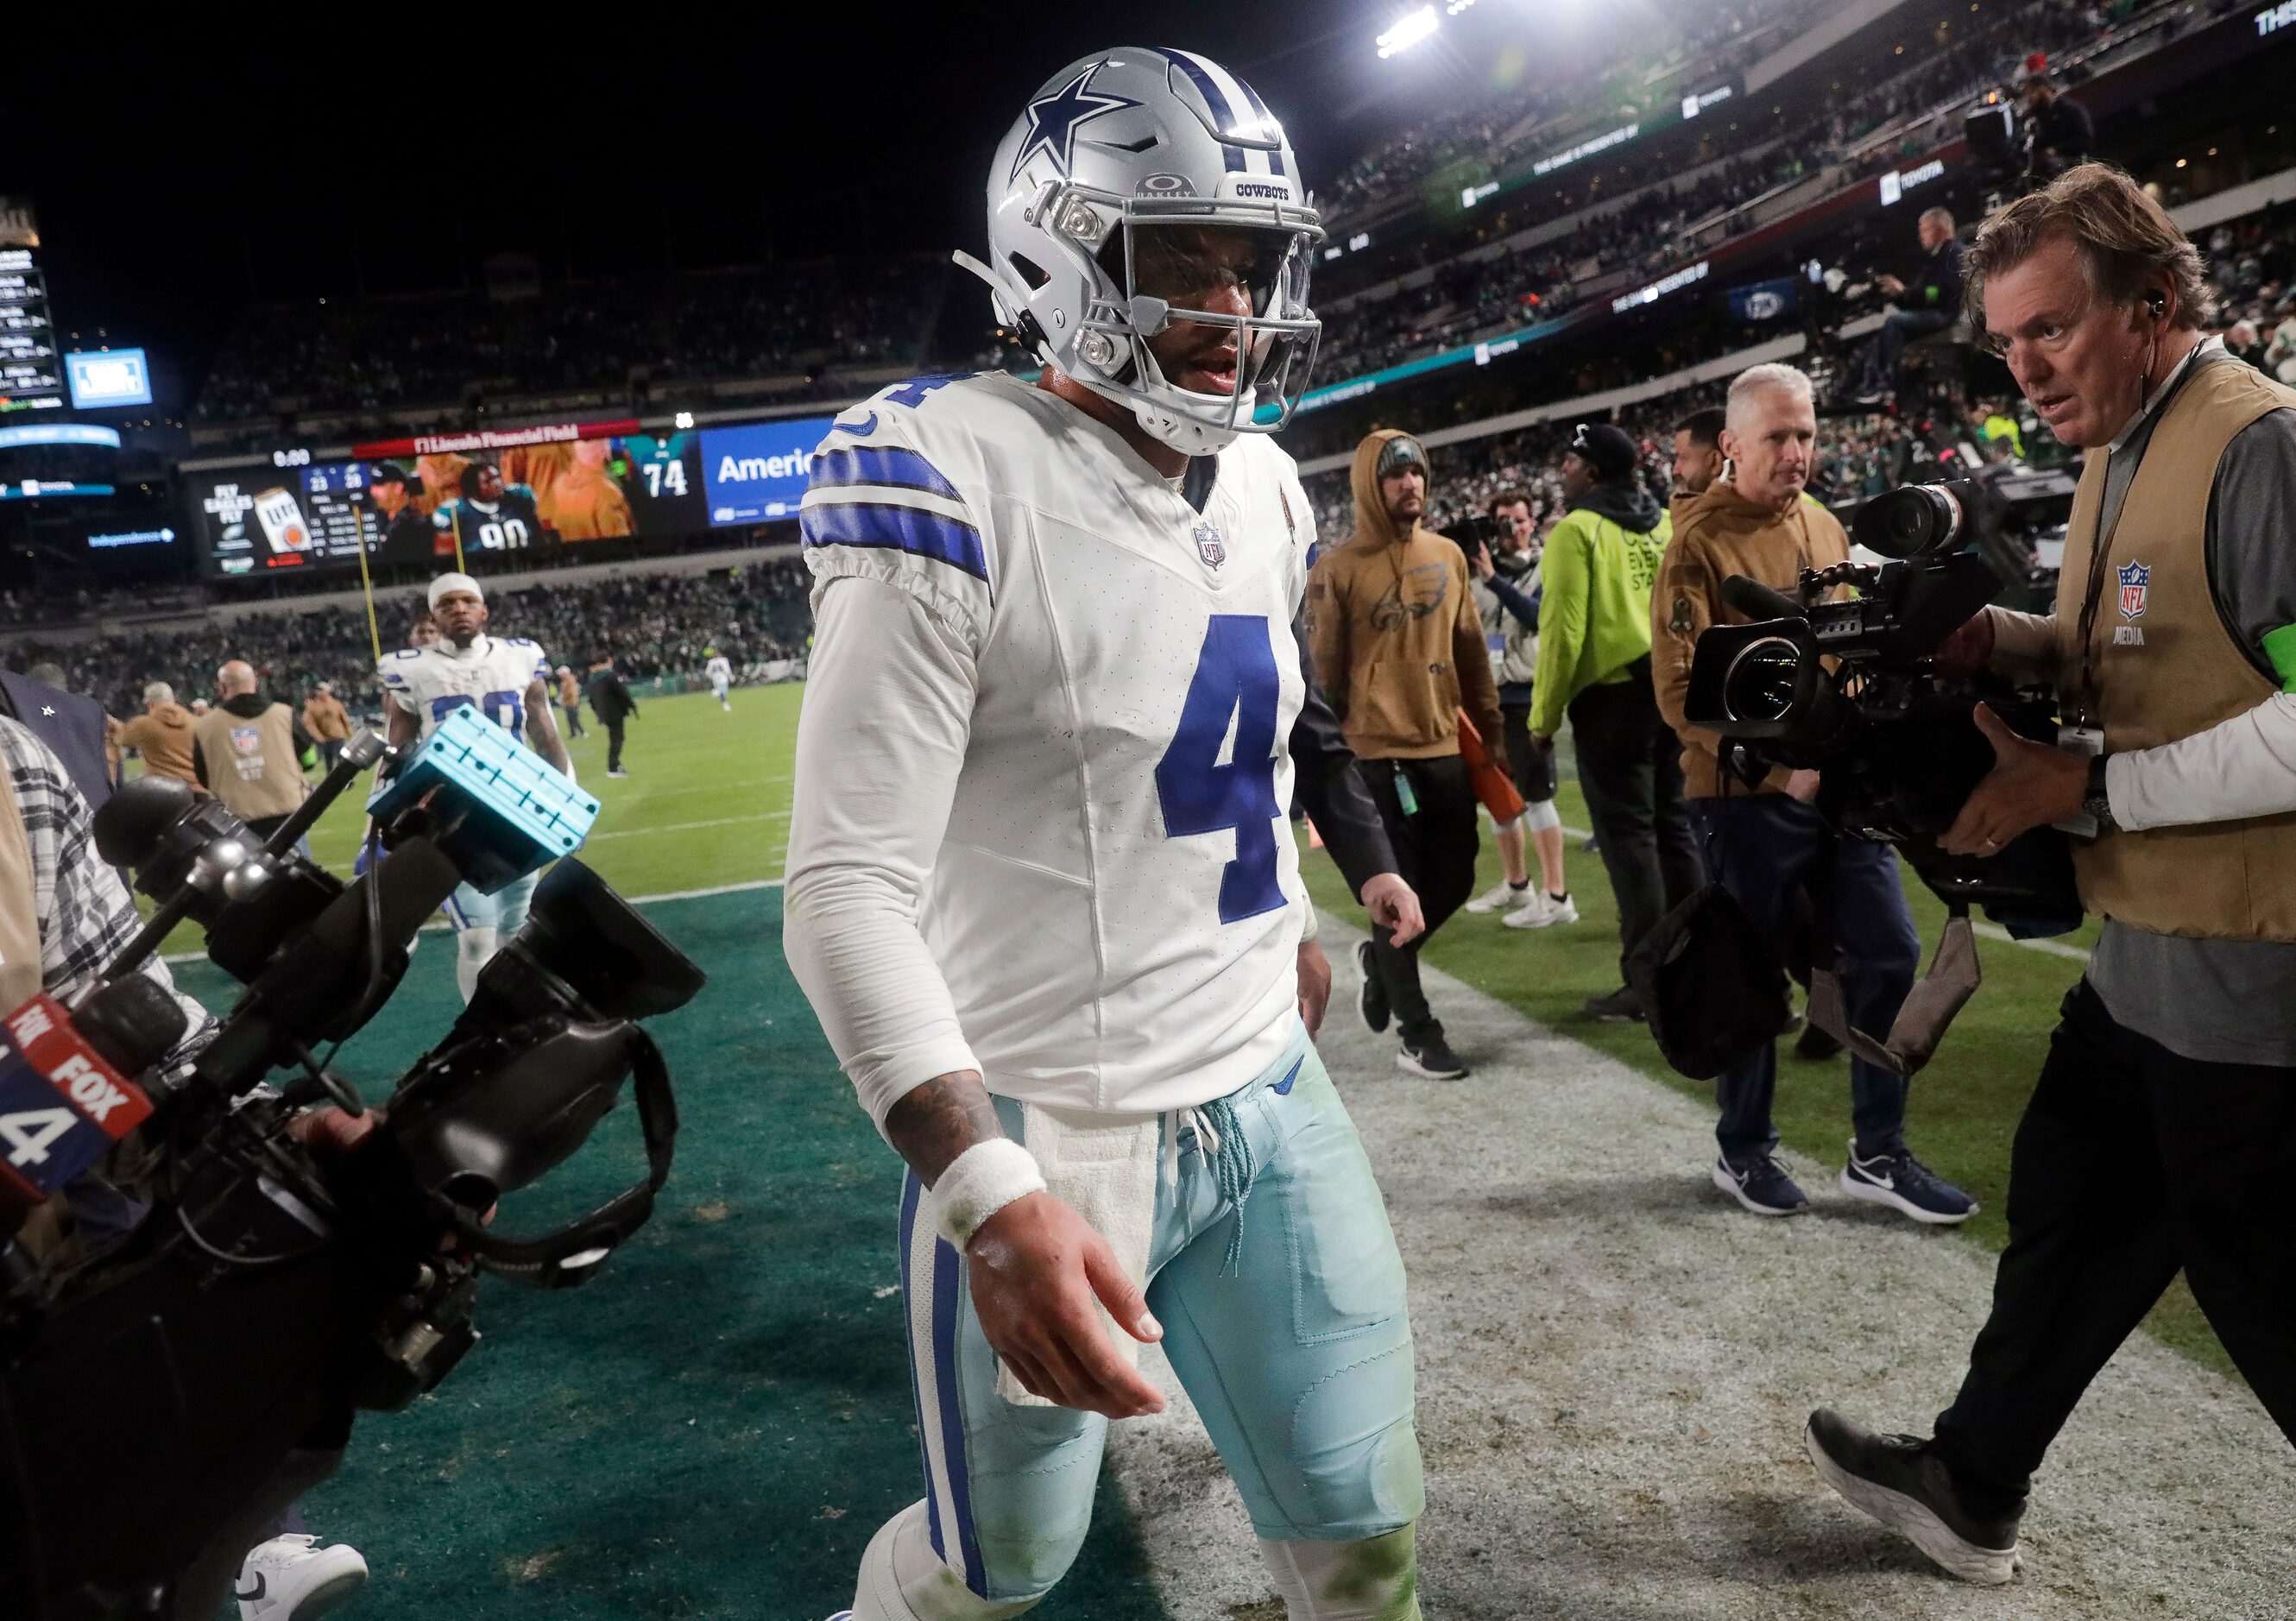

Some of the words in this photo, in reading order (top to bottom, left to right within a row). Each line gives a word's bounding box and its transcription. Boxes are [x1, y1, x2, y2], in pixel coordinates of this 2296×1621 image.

[1901, 159, 1945, 191] TOYOTA
[1236, 183, 1289, 201] COWBOYS
[642, 458, 689, 497] 74
[1203, 543, 1223, 561] NFL
[2123, 586, 2144, 613] NFL
[2113, 626, 2145, 646] MEDIA
[1156, 615, 1289, 924] 4
[49, 1053, 129, 1122] FOX
[0, 1107, 79, 1168] 4
